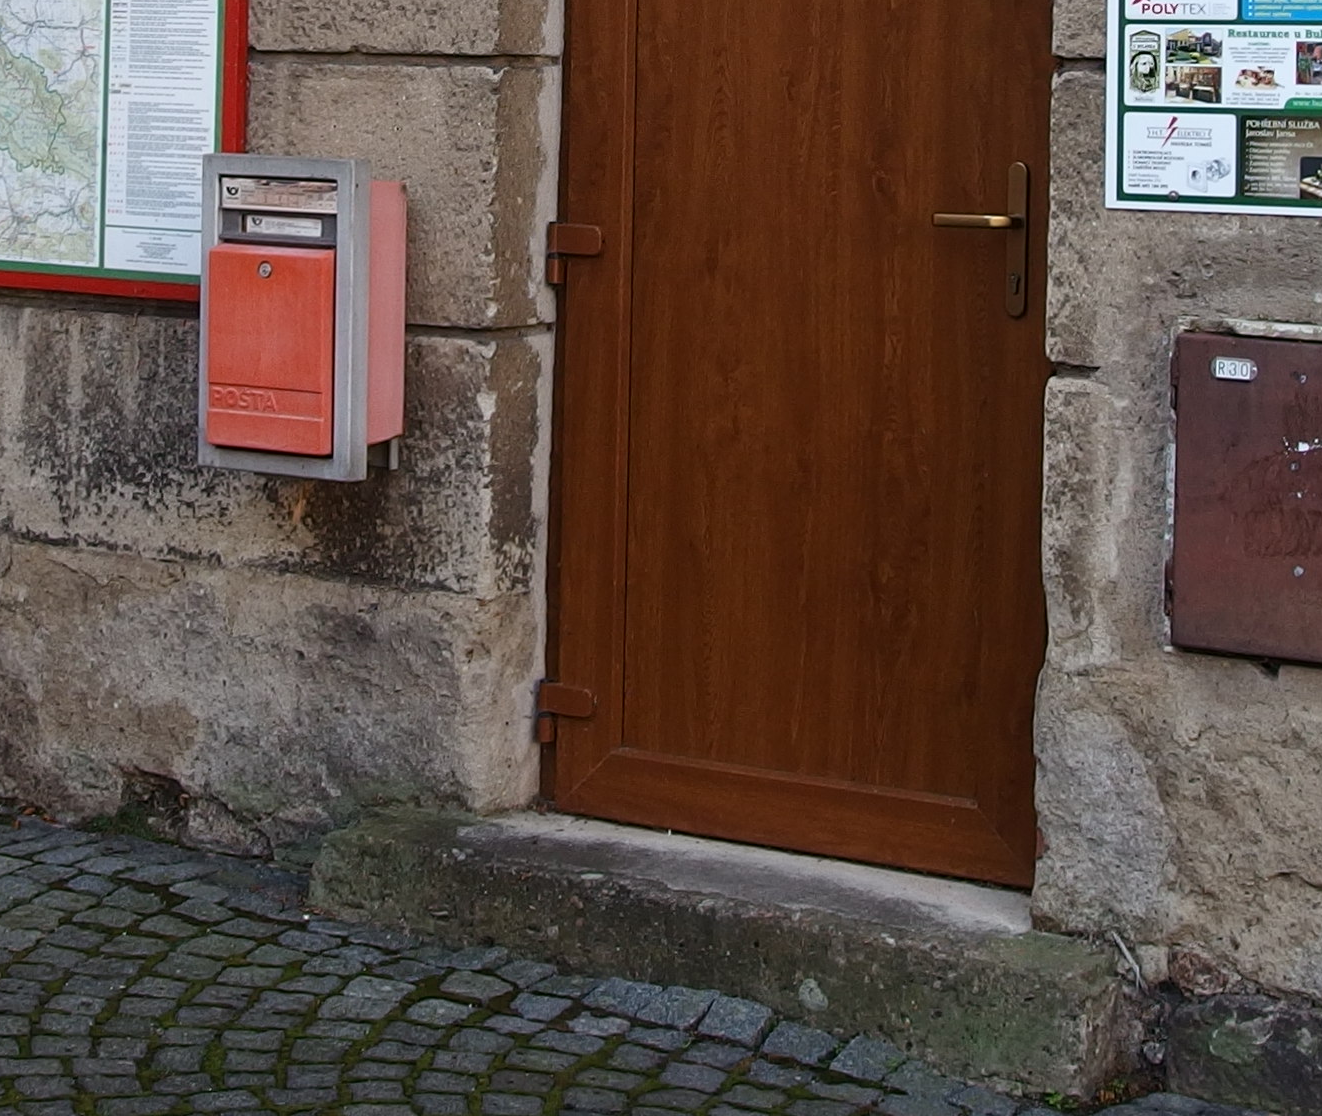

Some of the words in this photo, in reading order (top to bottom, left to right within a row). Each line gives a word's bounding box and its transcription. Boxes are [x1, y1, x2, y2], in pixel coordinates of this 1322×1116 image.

[1142, 4, 1206, 14] POLYTEX
[1228, 29, 1289, 38] Restaurace
[1289, 120, 1320, 129] SLUŽBA
[1216, 360, 1251, 380] R30
[211, 386, 278, 412] POŠTA
